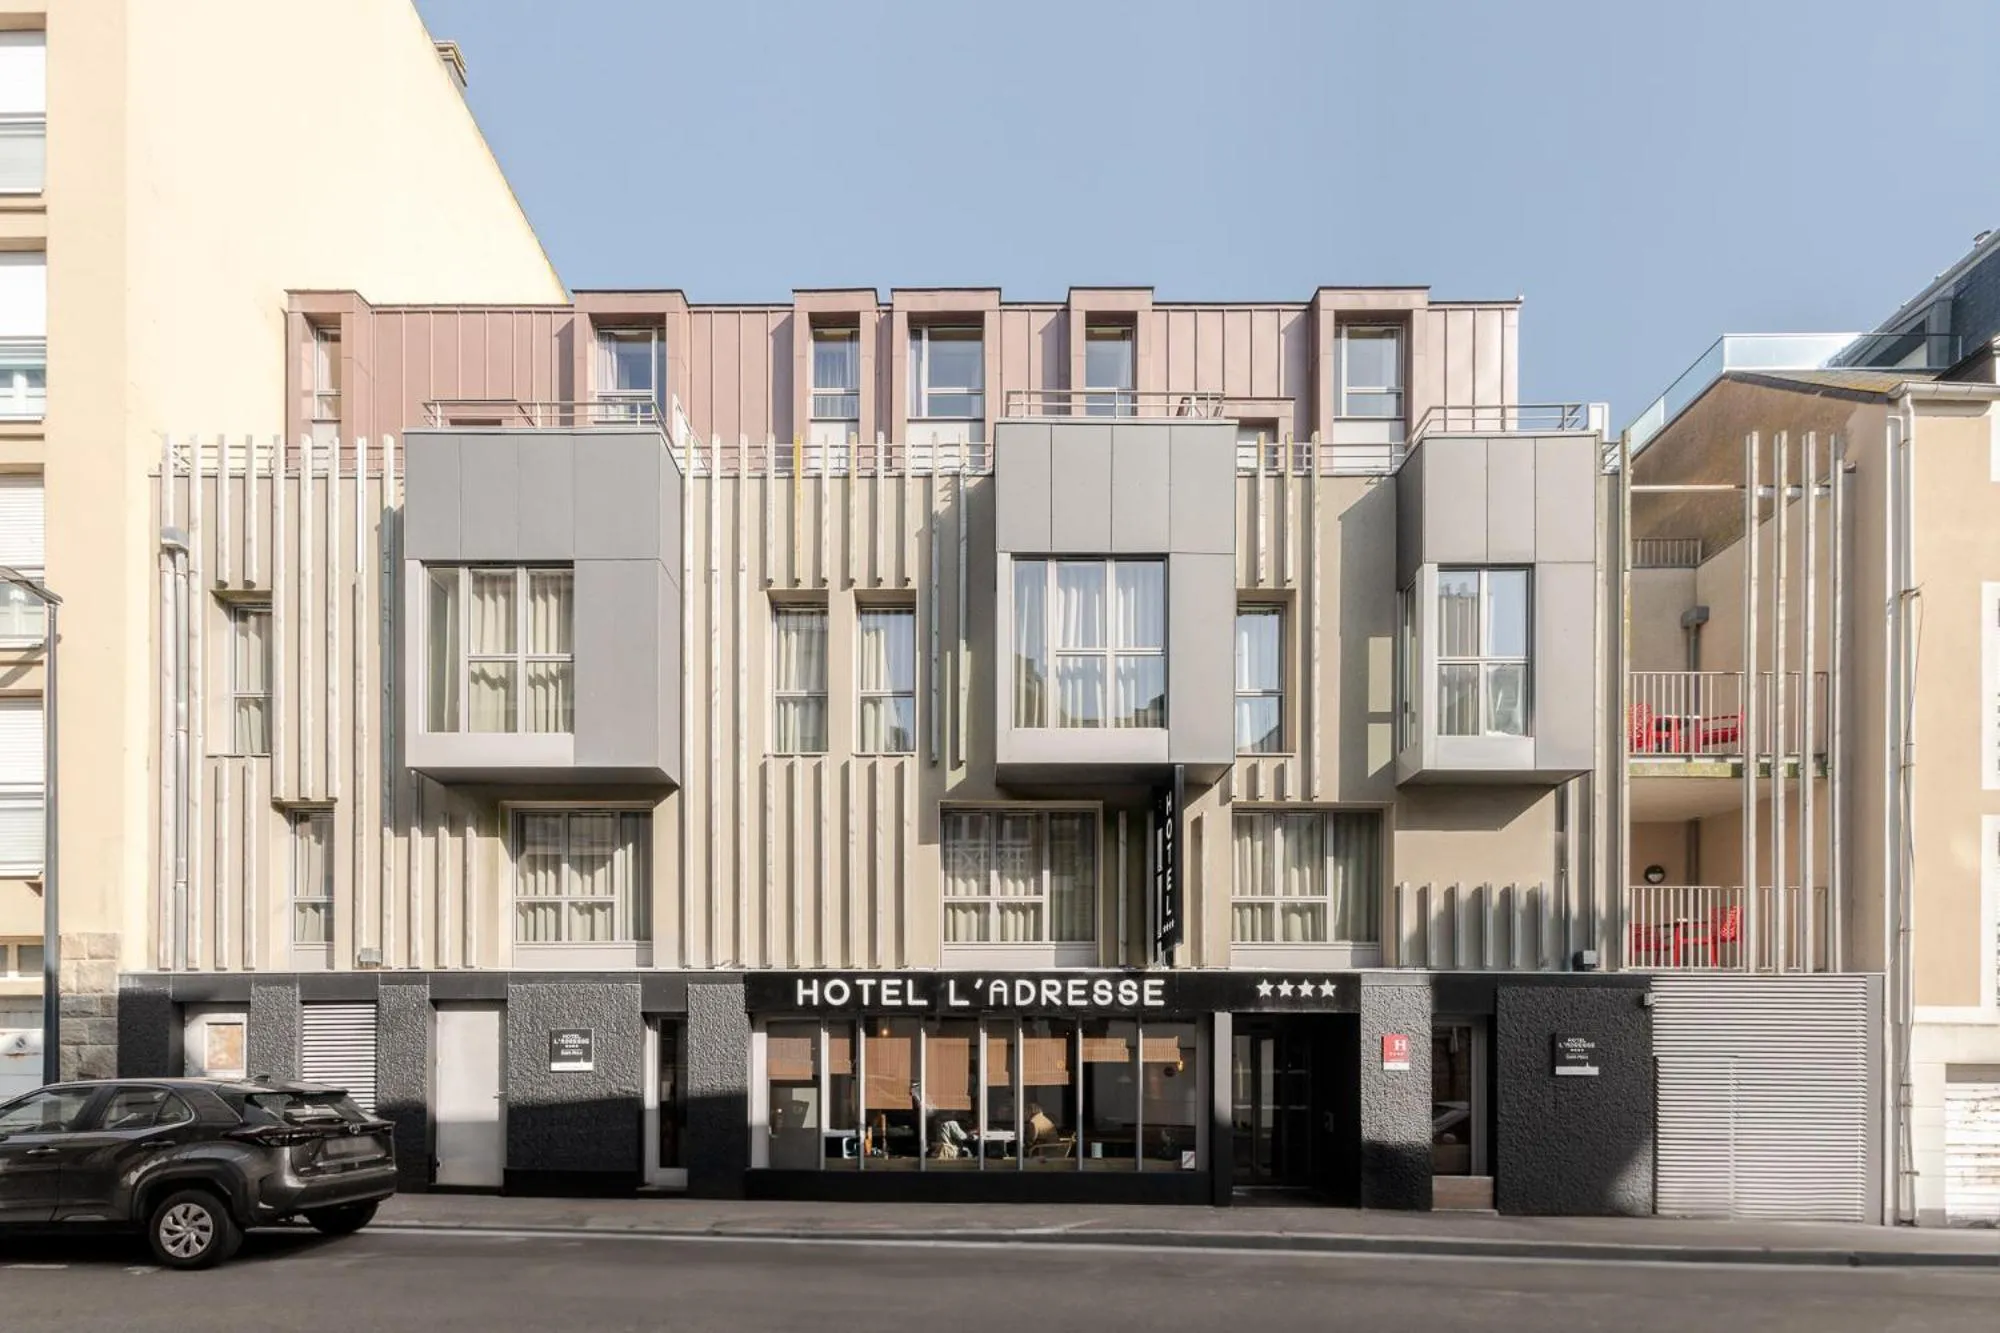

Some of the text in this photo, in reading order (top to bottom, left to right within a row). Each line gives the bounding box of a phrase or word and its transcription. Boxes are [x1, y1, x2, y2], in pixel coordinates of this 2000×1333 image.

[796, 979, 1165, 1006] HOTEL L'ADRESSE
[1395, 1040, 1406, 1050] H
